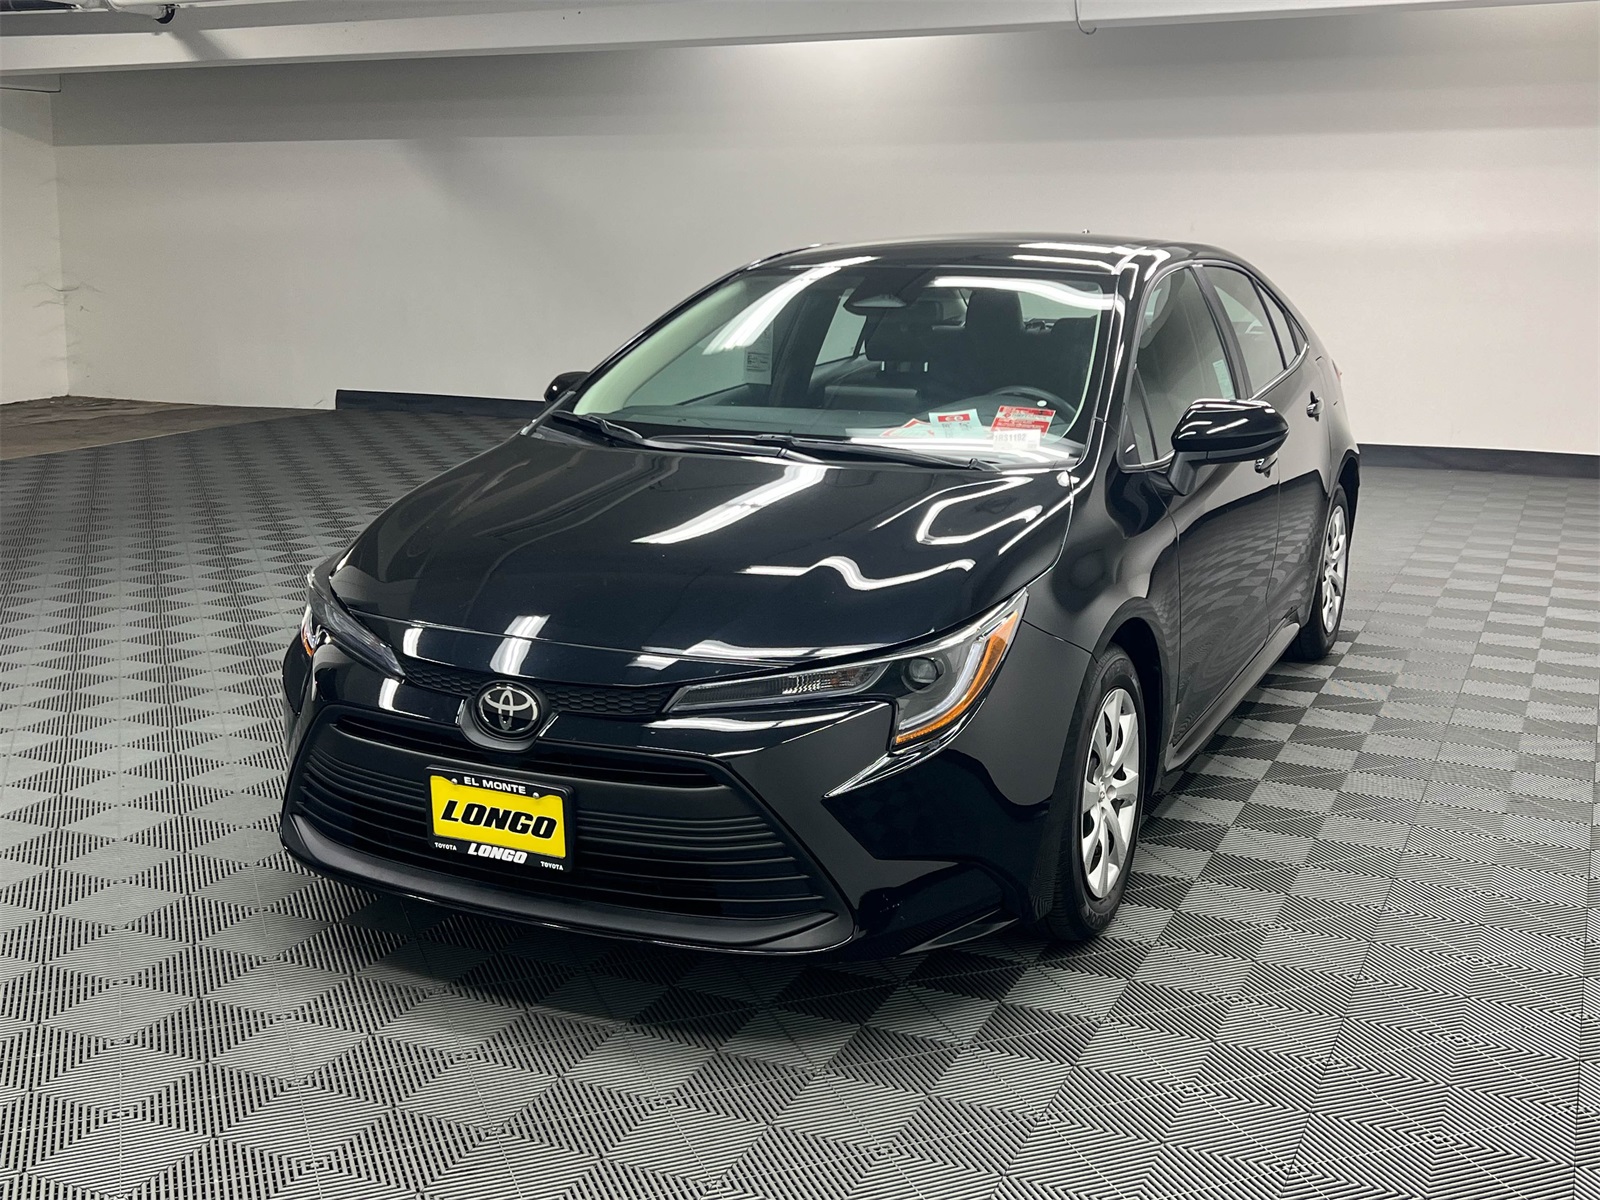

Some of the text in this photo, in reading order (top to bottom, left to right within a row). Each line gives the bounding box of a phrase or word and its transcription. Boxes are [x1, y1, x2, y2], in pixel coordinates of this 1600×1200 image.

[463, 776, 526, 794] EL MONTE
[441, 800, 557, 839] LONGO
[434, 842, 563, 870] TOYOTA LONGO TOYOTA
